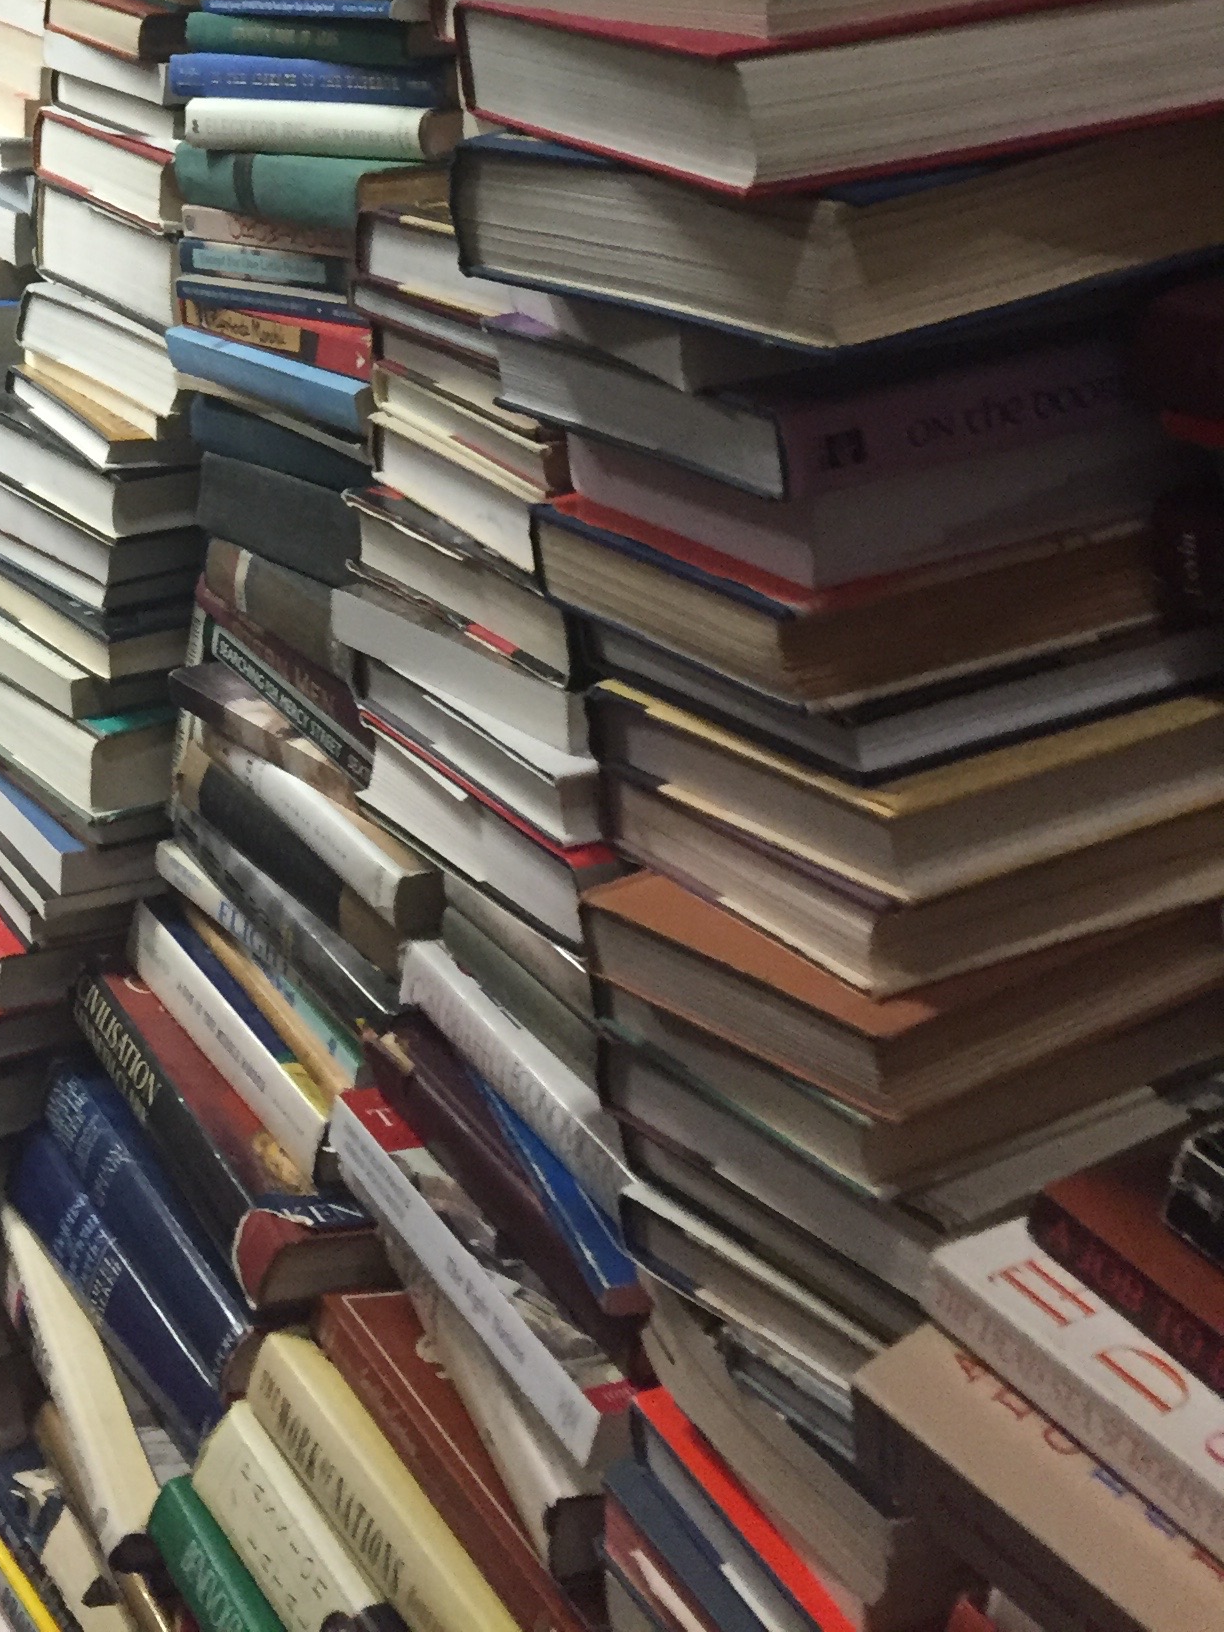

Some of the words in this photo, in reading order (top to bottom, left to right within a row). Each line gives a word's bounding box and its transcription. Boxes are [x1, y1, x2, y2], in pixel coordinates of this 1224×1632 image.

[217, 639, 266, 691] SEARCHING
[279, 693, 310, 729] MERCY
[309, 720, 344, 759] STREET
